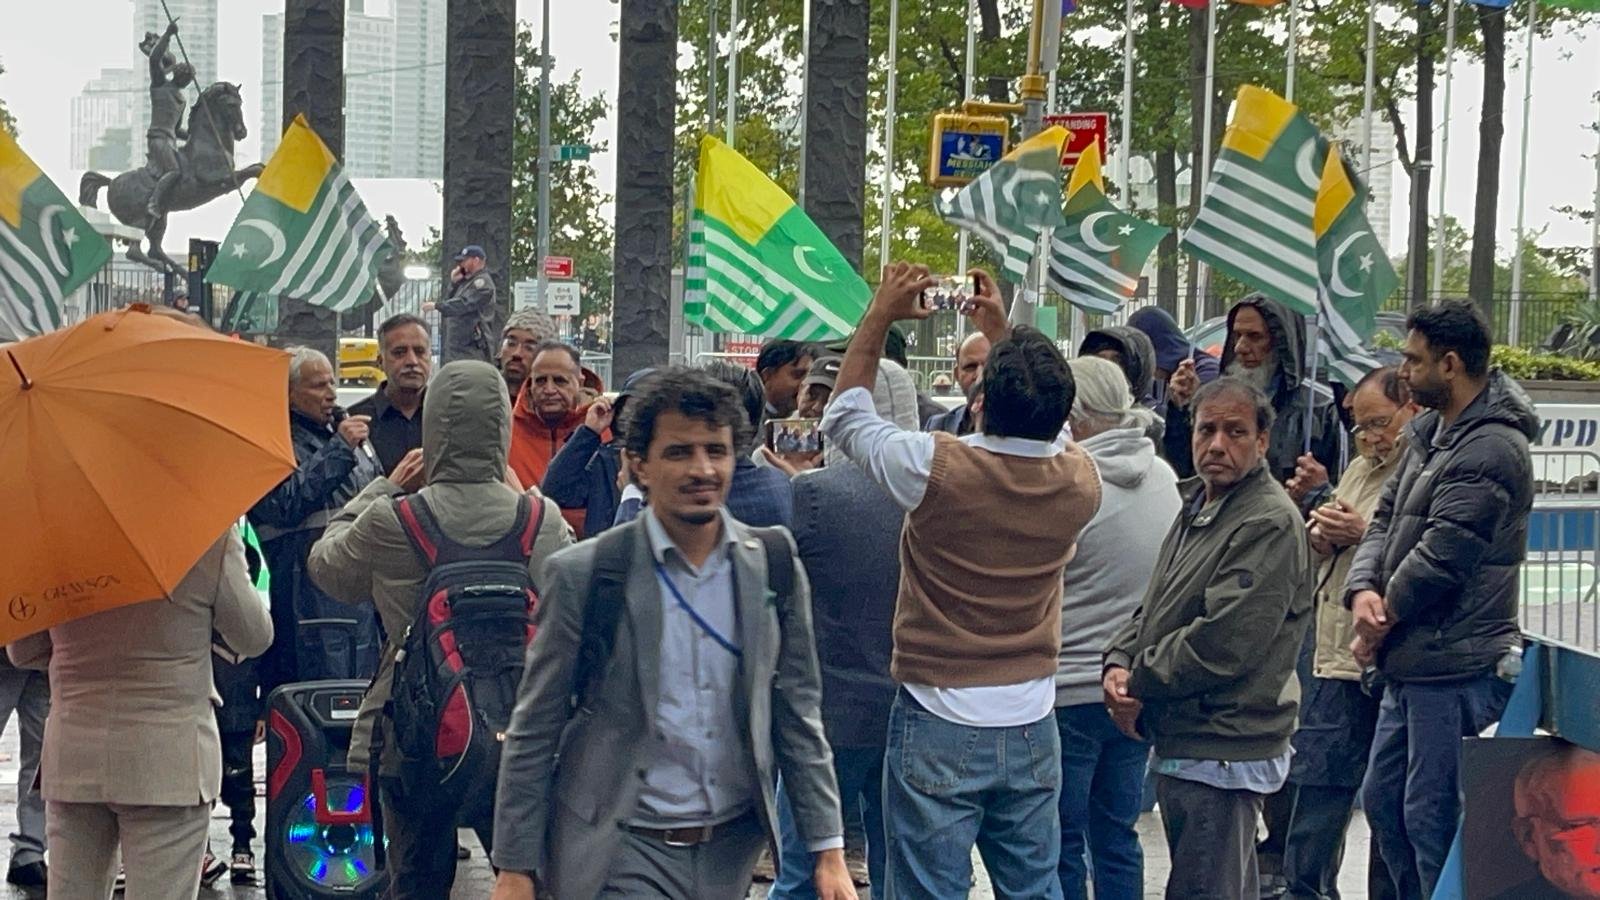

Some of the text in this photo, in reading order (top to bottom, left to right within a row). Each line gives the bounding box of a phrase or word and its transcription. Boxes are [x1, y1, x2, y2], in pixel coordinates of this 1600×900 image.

[1054, 119, 1097, 130] STANDING
[731, 345, 759, 355] STOP
[1533, 419, 1597, 447] YPD
